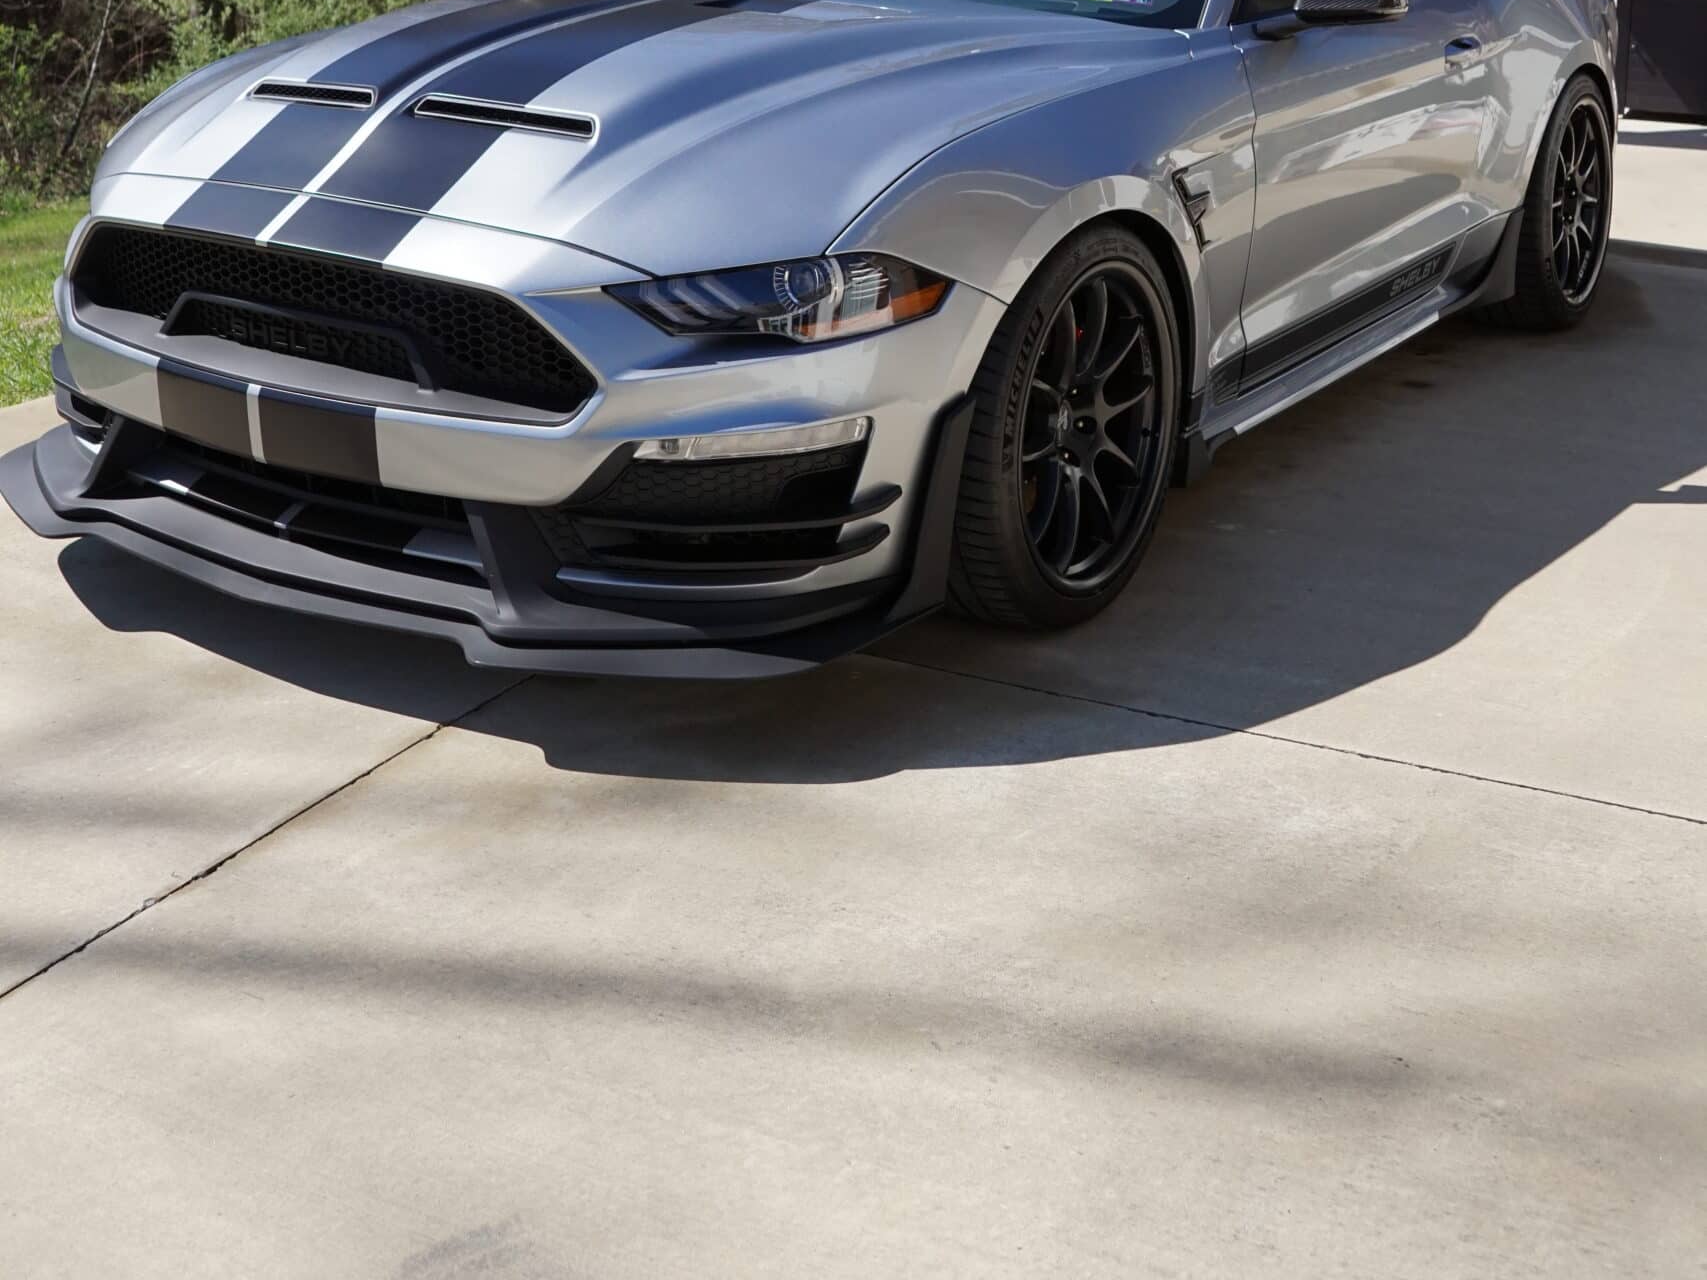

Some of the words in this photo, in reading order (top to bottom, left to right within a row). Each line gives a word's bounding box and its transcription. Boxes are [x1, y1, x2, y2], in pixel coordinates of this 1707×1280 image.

[1389, 256, 1441, 298] SHELBY
[230, 317, 353, 359] SHELBY
[1004, 308, 1044, 438] MICHELIN
